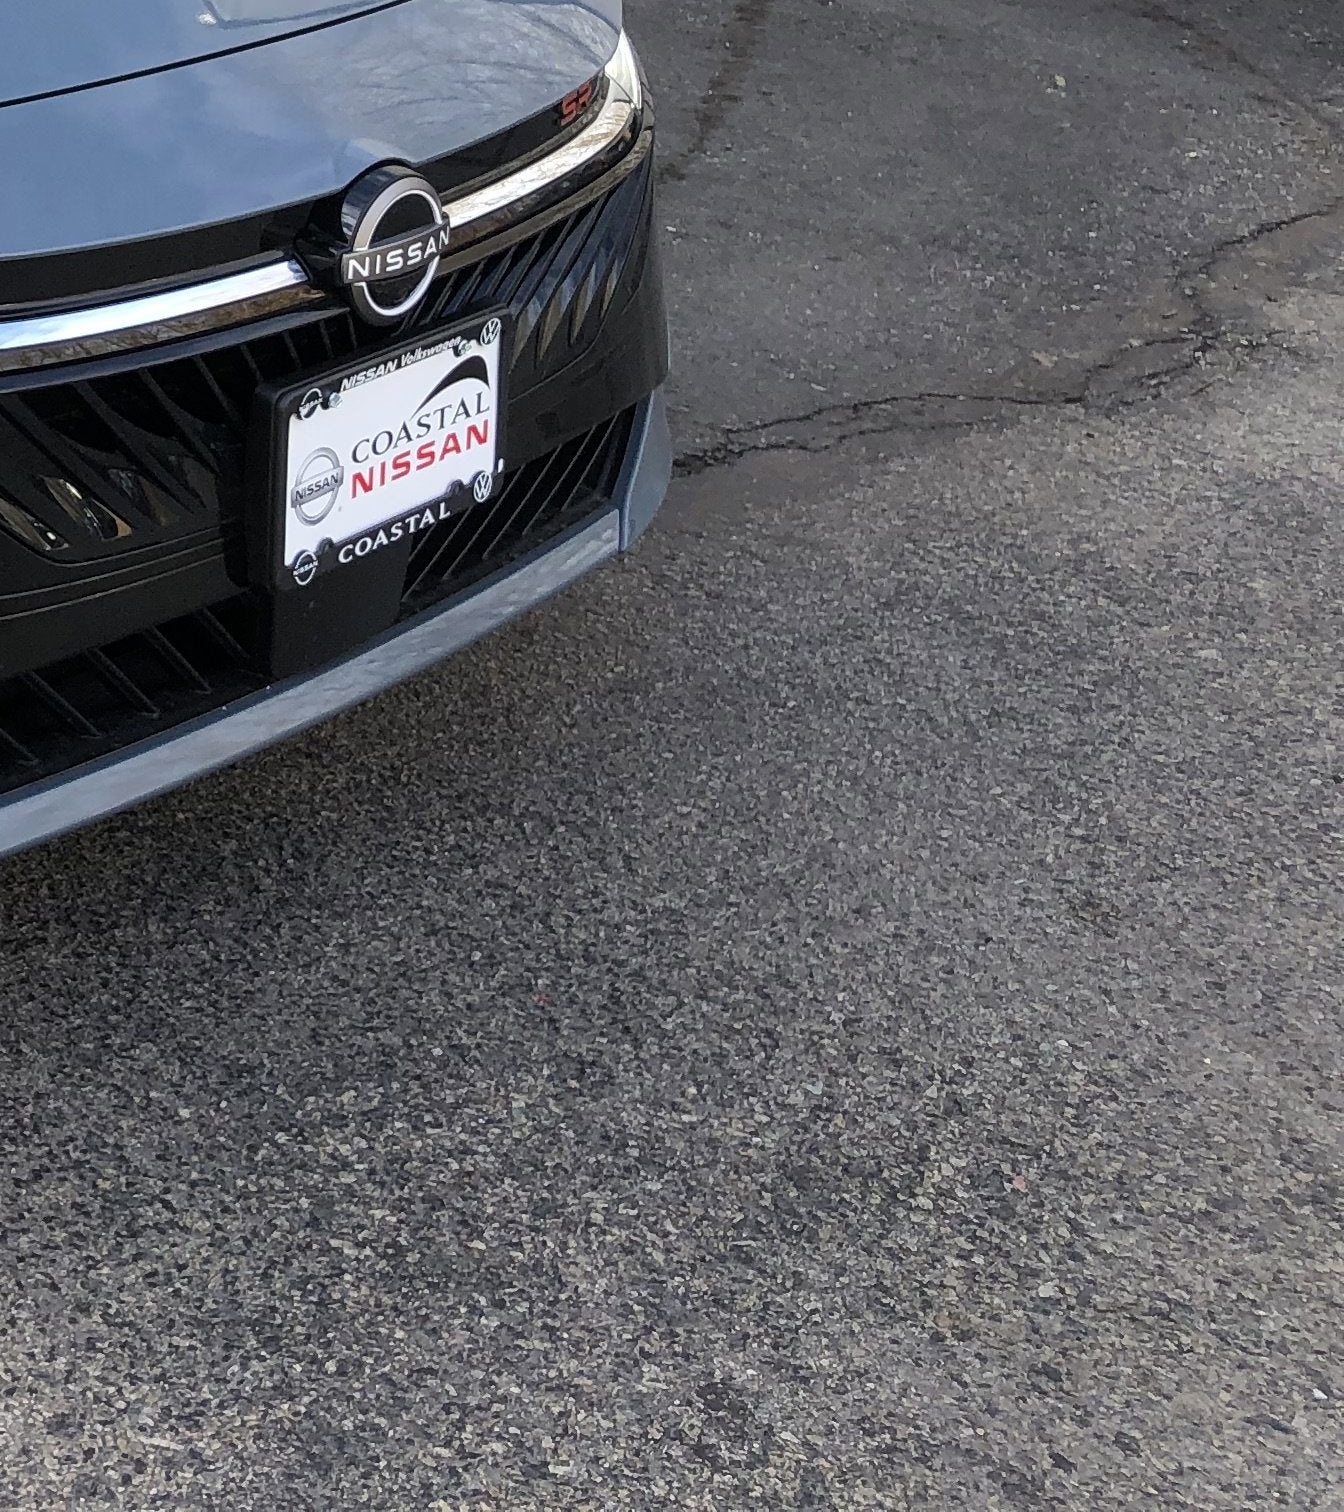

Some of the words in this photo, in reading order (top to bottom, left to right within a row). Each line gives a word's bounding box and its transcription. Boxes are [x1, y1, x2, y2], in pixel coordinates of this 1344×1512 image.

[348, 225, 450, 280] NISSAN
[340, 358, 398, 392] NISSAN
[401, 335, 462, 367] Volkswagen
[351, 392, 490, 464] COASTAL
[295, 472, 340, 502] NISSAN
[351, 419, 489, 499] NISSAN
[338, 501, 451, 564] COASTAL
